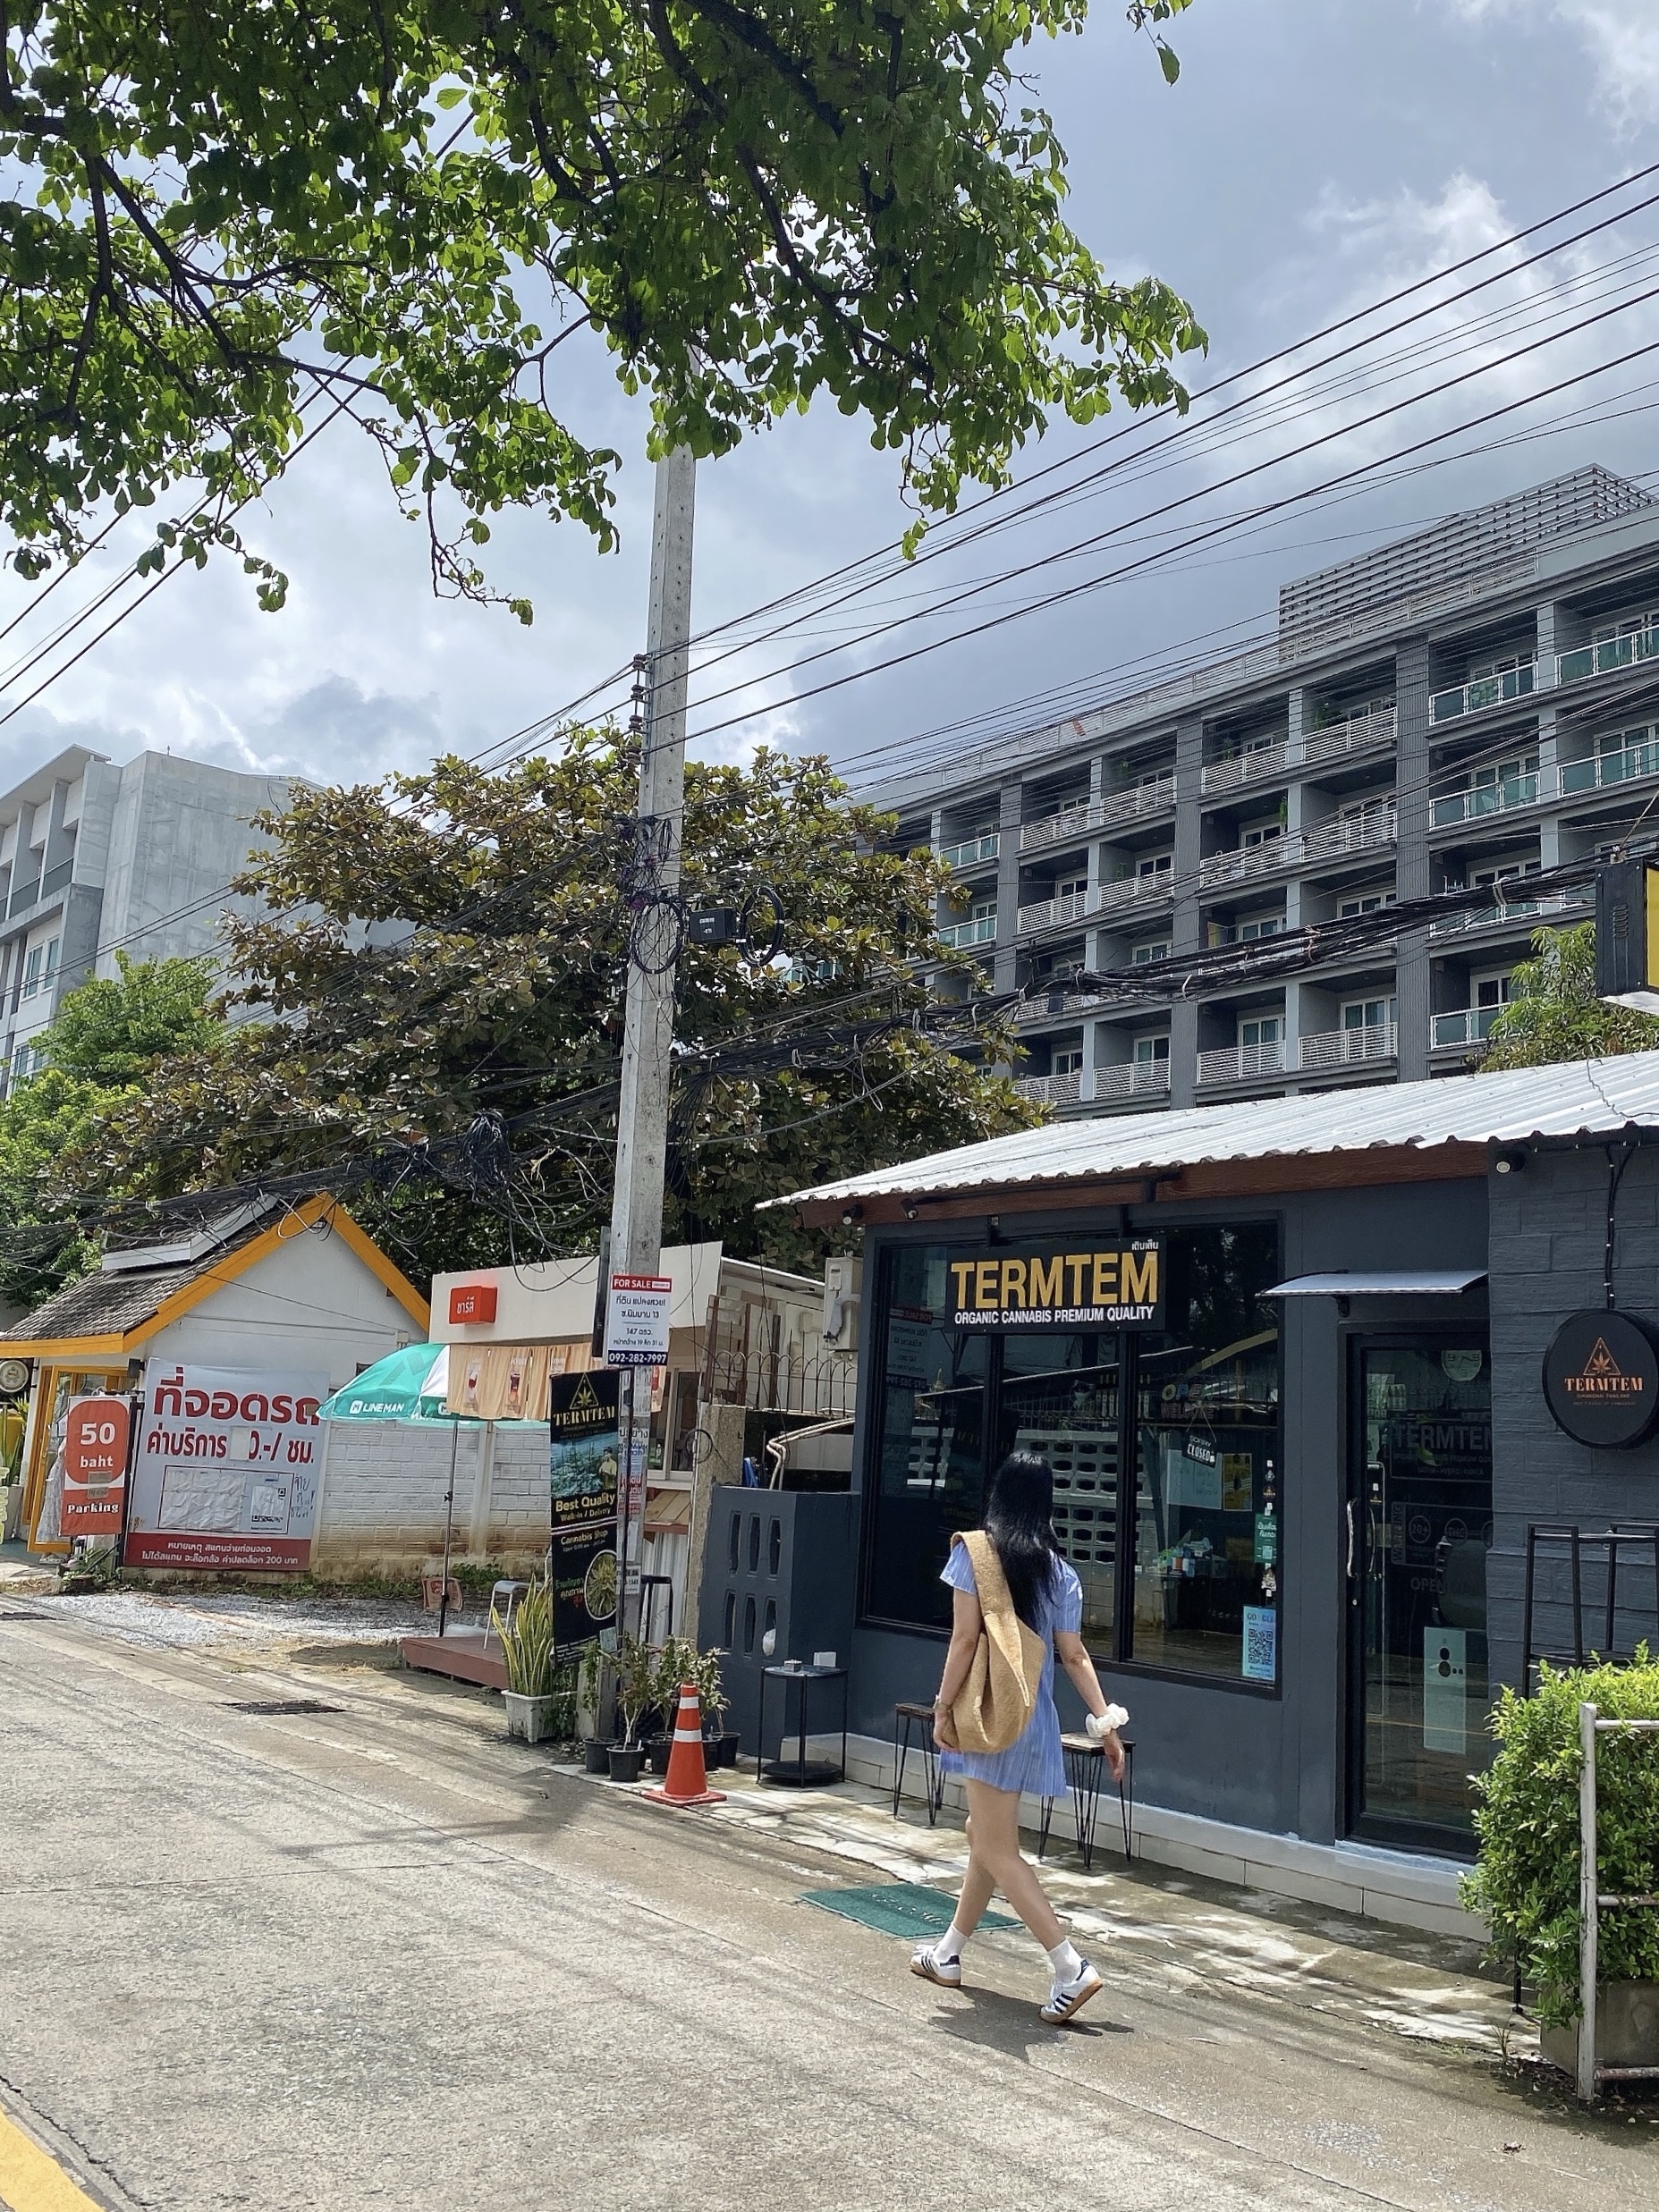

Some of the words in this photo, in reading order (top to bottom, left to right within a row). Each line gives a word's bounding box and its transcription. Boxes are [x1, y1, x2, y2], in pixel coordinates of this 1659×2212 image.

[614, 1278, 630, 1288] FOR
[631, 1279, 651, 1288] SALE
[951, 1251, 1158, 1309] TERMTEM
[652, 1311, 659, 1319] 13
[954, 1310, 999, 1324] ORGANIC
[1001, 1309, 1052, 1323] CANNABIS
[1054, 1307, 1105, 1322] PREMIUM
[1106, 1305, 1155, 1321] QUALITY
[626, 1327, 638, 1335] 147
[608, 1352, 667, 1363] 092-282-7997
[1564, 1377, 1643, 1391] TERMTEM
[153, 1366, 320, 1425] ที่จอดรถ
[554, 1406, 615, 1426] TERMTEM
[80, 1422, 115, 1445] 50
[147, 1423, 227, 1458] ค่าบริการ
[1187, 1443, 1211, 1462] CLOSED
[80, 1455, 114, 1468] baht
[67, 1502, 119, 1514] Parking
[555, 1498, 580, 1512] Best
[581, 1491, 616, 1508] Quality
[589, 1507, 611, 1517] Delivery
[561, 1532, 593, 1545] Cannabis
[167, 1541, 202, 1553] หมายเหตุ
[266, 1557, 282, 1565] 200
